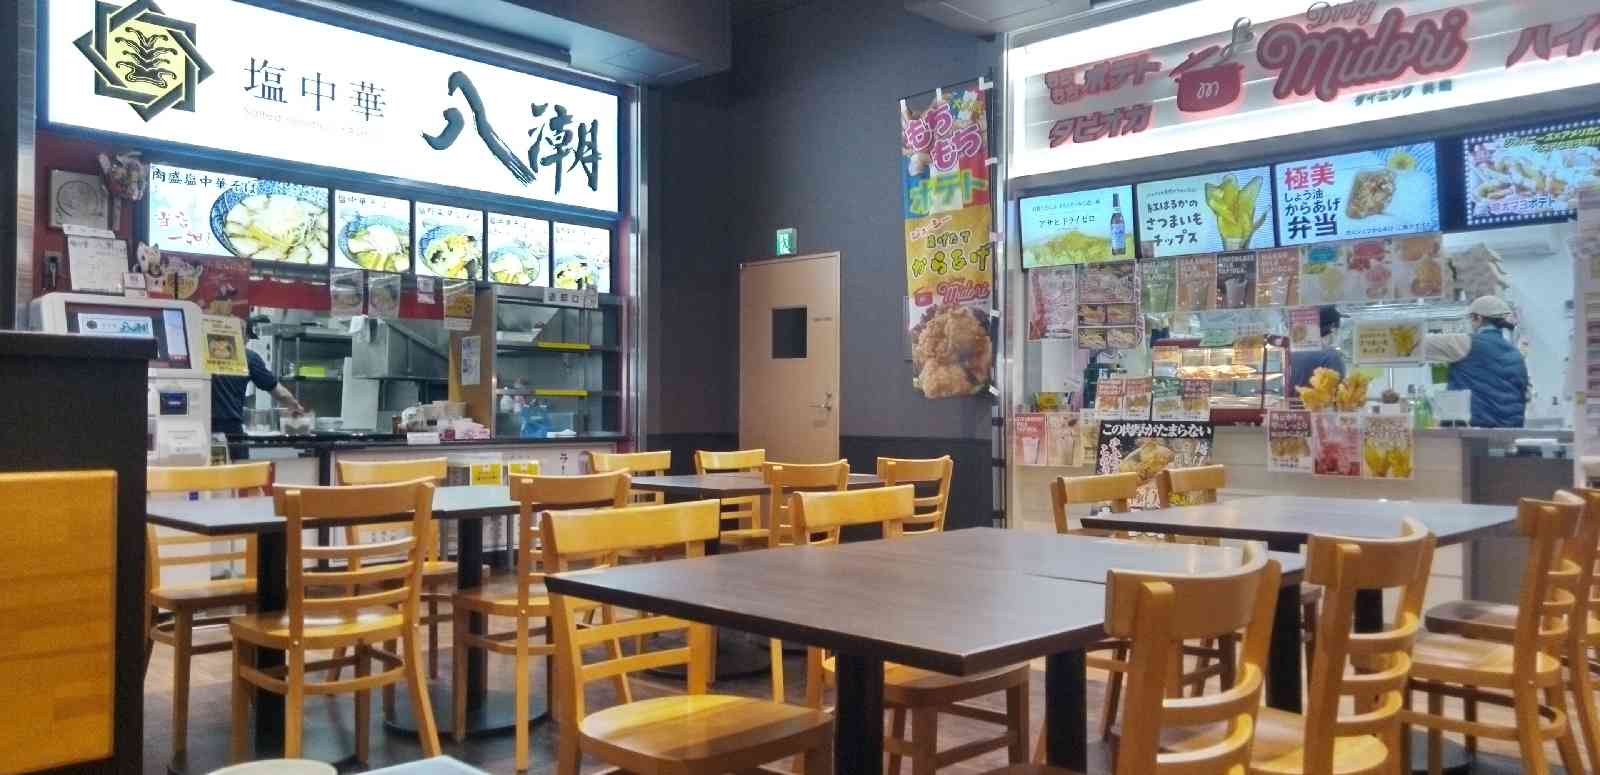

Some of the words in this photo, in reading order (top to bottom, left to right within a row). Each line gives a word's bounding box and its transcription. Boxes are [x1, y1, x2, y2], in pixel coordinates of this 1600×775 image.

[1256, 8, 1469, 101] Midori
[243, 57, 387, 122] 塩中華
[421, 70, 602, 195] 八潮
[1049, 104, 1153, 148] タピオカ
[1284, 161, 1336, 191] 極美
[909, 170, 988, 216] ポテト
[1284, 189, 1324, 203] しょう油
[1285, 196, 1341, 217] からあげ
[1146, 212, 1203, 231] さつまいも
[1287, 213, 1338, 240] 弁当
[1153, 228, 1199, 247] チップス
[937, 280, 990, 305] Midori
